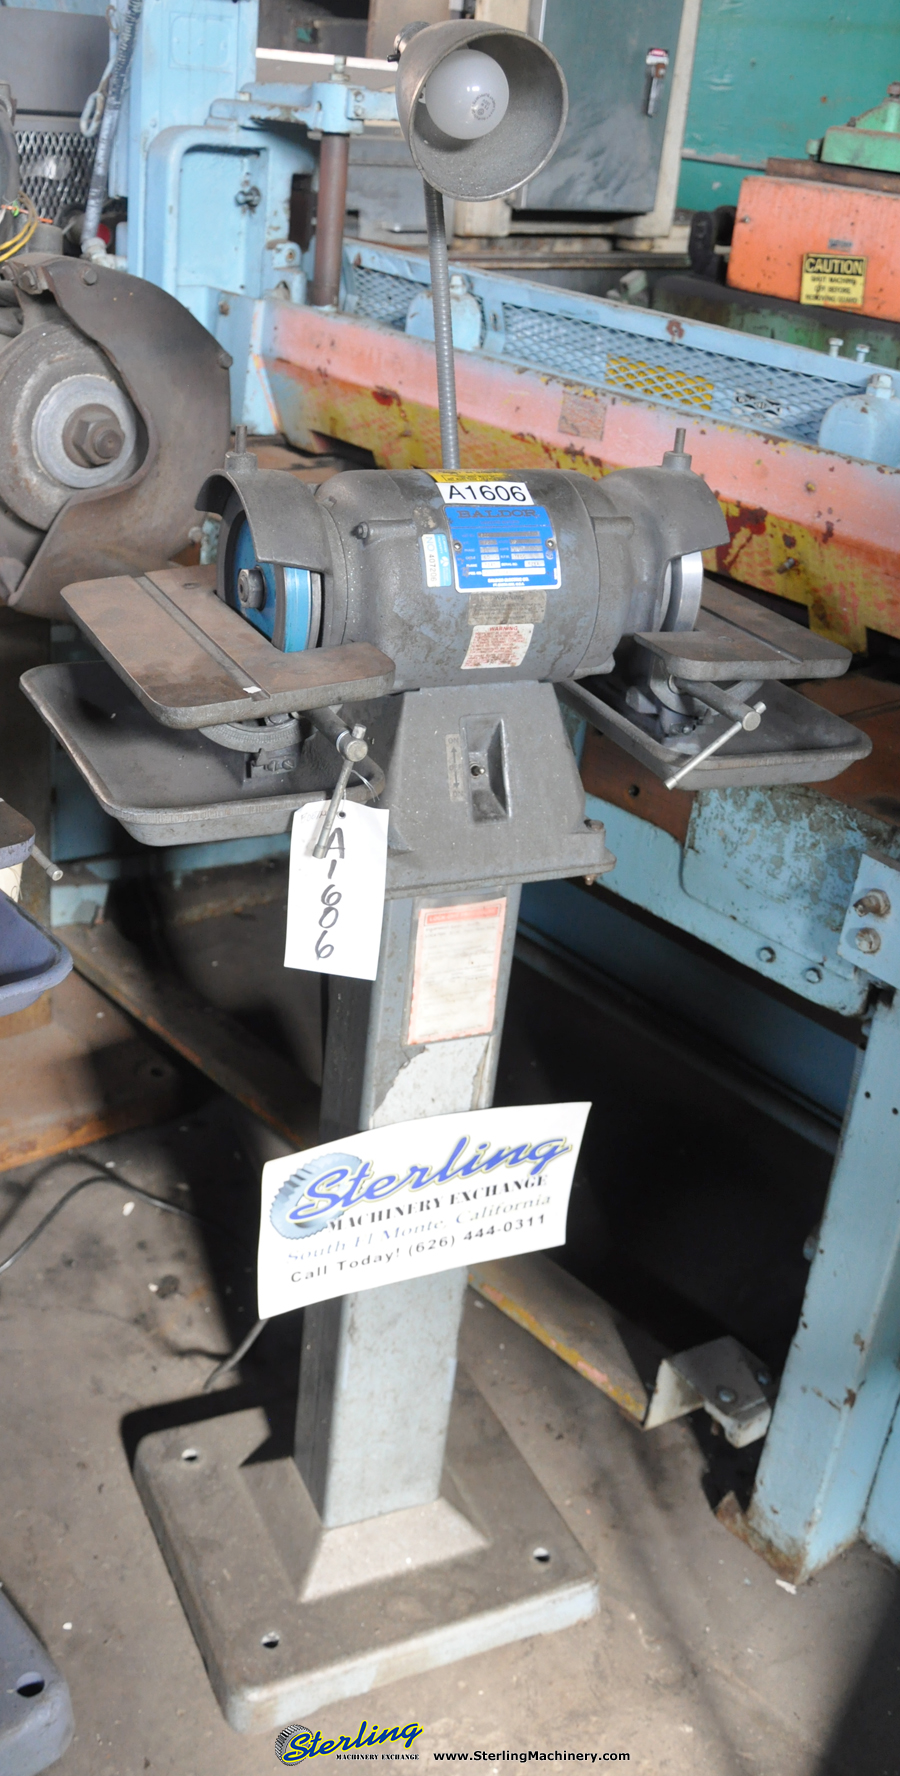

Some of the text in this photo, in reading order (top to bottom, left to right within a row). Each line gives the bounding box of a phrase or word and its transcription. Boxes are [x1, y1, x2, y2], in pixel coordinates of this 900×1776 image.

[804, 257, 863, 275] CAUTION
[448, 484, 527, 502] A1606
[456, 509, 537, 519] BALDOR
[286, 1135, 572, 1223] Sterling
[328, 1174, 548, 1233] MACHINERY EXCHANGE
[456, 1193, 551, 1224] California
[290, 1213, 546, 1283] Call Today! (626) 444-0311
